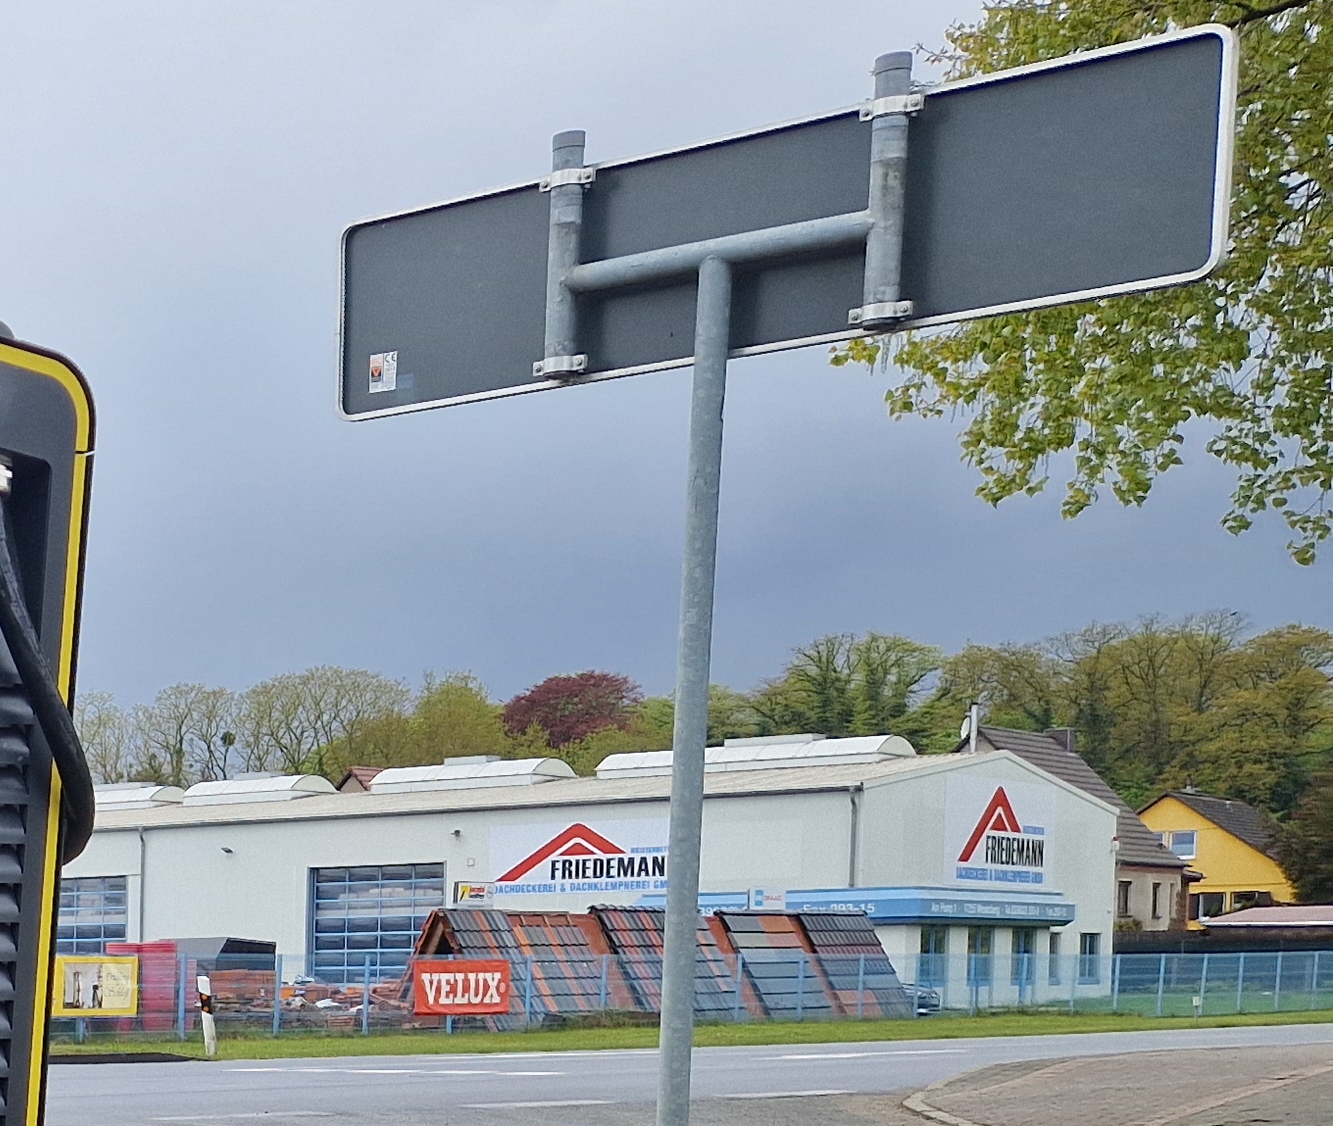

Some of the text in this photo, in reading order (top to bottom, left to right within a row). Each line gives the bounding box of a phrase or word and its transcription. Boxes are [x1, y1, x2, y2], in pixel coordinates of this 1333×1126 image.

[984, 835, 1045, 868] FRIEDEMANN
[549, 856, 666, 881] FRIEDEMAN
[560, 883, 566, 892] &
[569, 880, 650, 892] DACHKLEMPNEREI
[653, 879, 671, 890] GM
[421, 972, 502, 1005] VELUX
